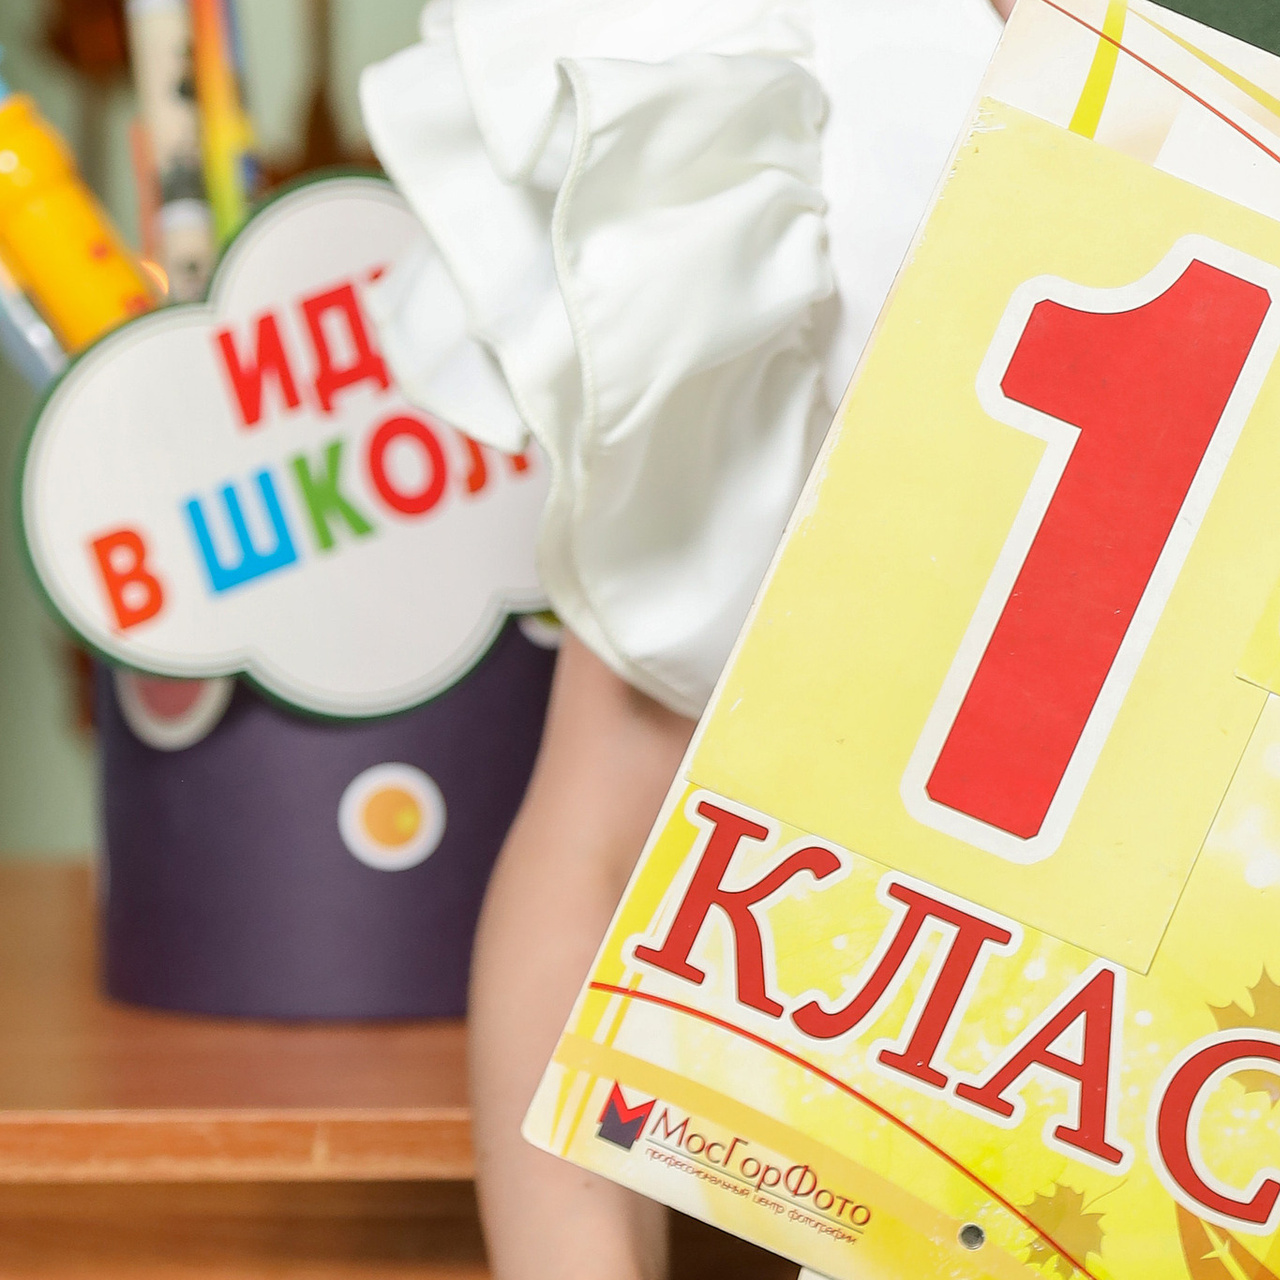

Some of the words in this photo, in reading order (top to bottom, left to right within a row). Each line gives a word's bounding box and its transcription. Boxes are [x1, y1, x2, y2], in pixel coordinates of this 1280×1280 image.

[215, 266, 391, 428] ИД
[90, 530, 165, 631] В
[650, 1107, 873, 1227] МосГорФото
